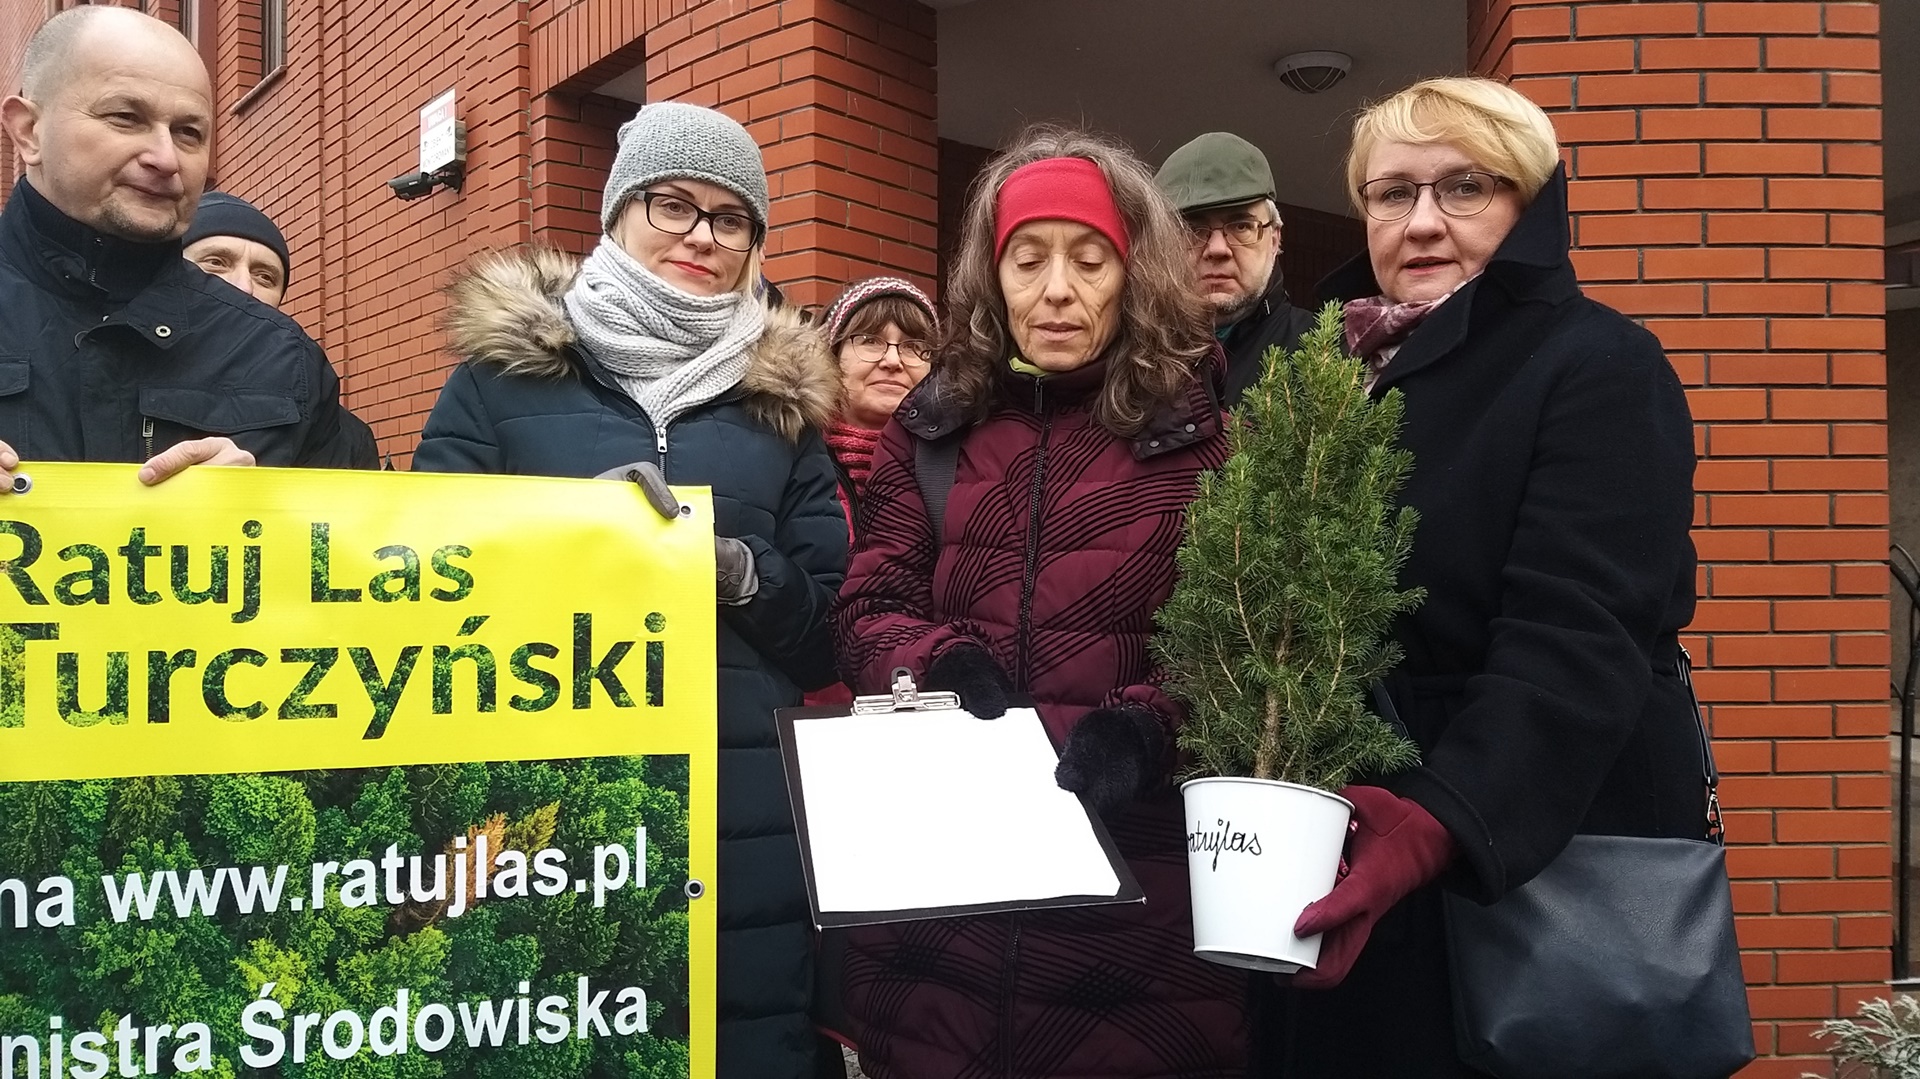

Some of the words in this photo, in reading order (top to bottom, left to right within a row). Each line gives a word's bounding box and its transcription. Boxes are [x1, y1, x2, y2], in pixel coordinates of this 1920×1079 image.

[0, 519, 263, 623] Ratuj
[311, 523, 476, 604] Las
[0, 612, 667, 741] Turczyński
[102, 827, 647, 924] www.ratujlas.pl
[1186, 818, 1262, 873] atujlas
[1, 1014, 213, 1079] nistra
[239, 975, 649, 1068] Środowiska
